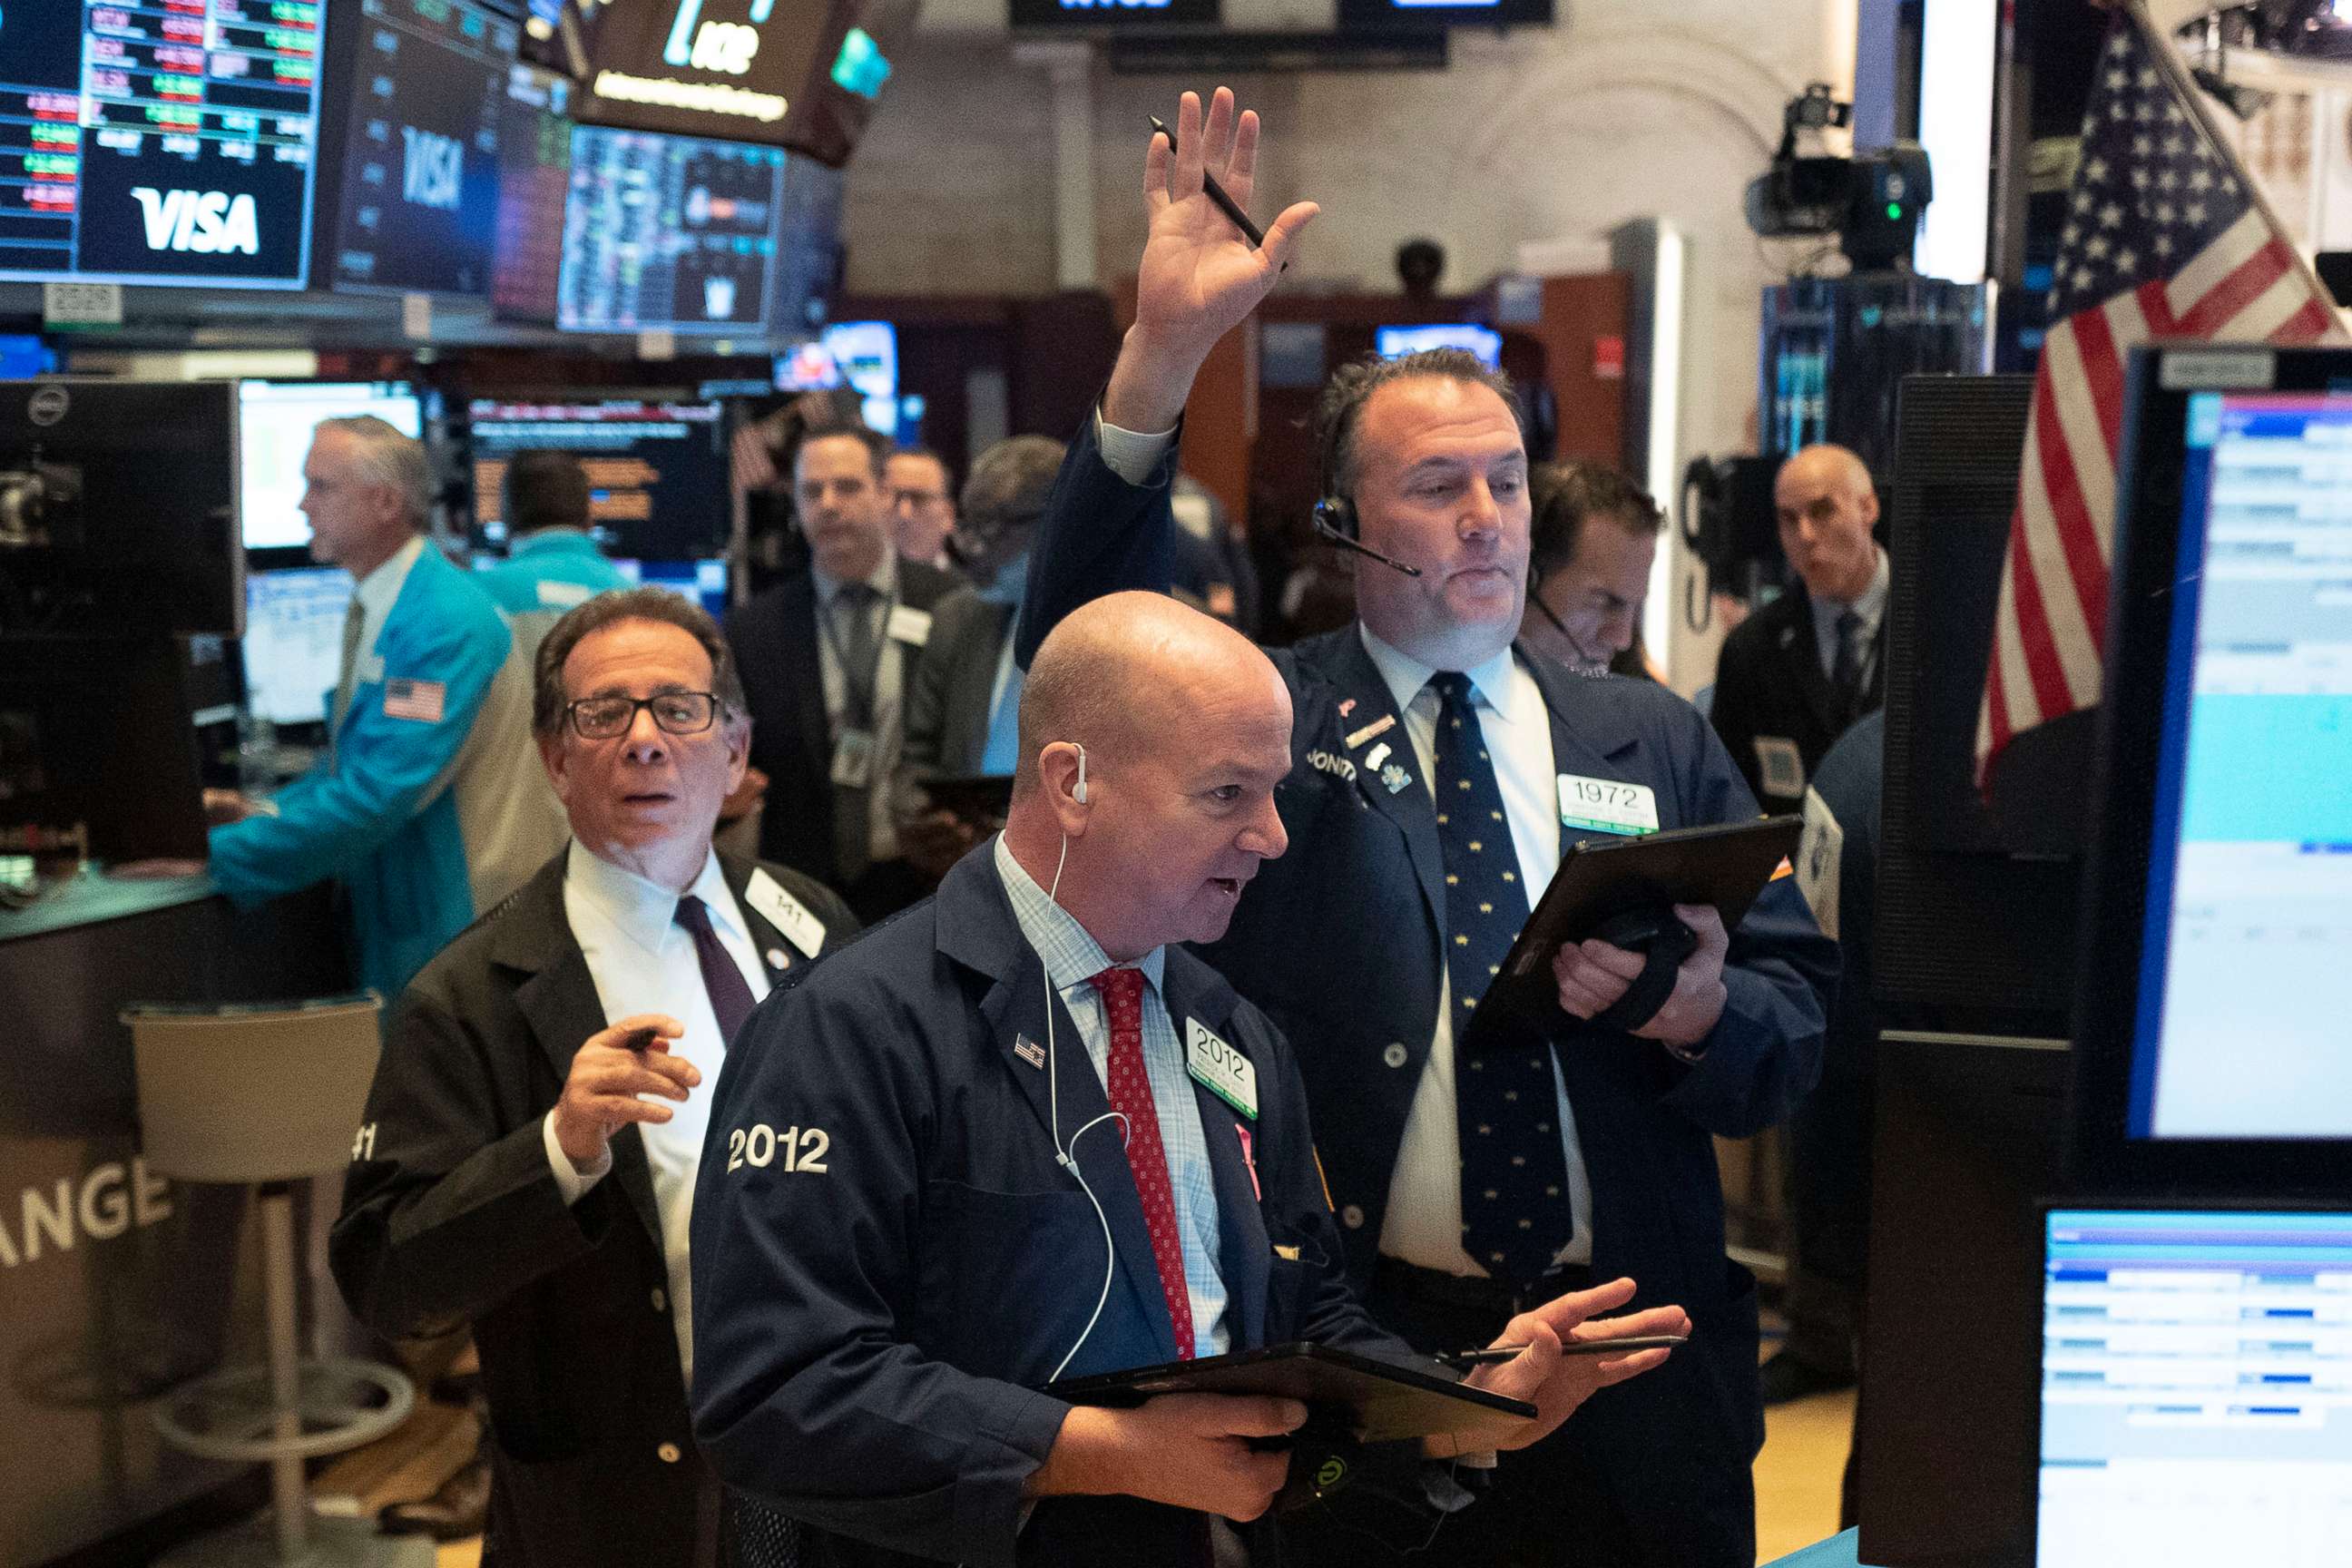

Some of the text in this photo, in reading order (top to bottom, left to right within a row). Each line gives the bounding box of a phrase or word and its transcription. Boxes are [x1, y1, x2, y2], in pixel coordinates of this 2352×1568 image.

[130, 187, 260, 255] VISA
[1576, 782, 1639, 808] 1972
[778, 895, 802, 924] 141
[1197, 1027, 1244, 1082] 2012
[727, 1123, 829, 1173] 2012
